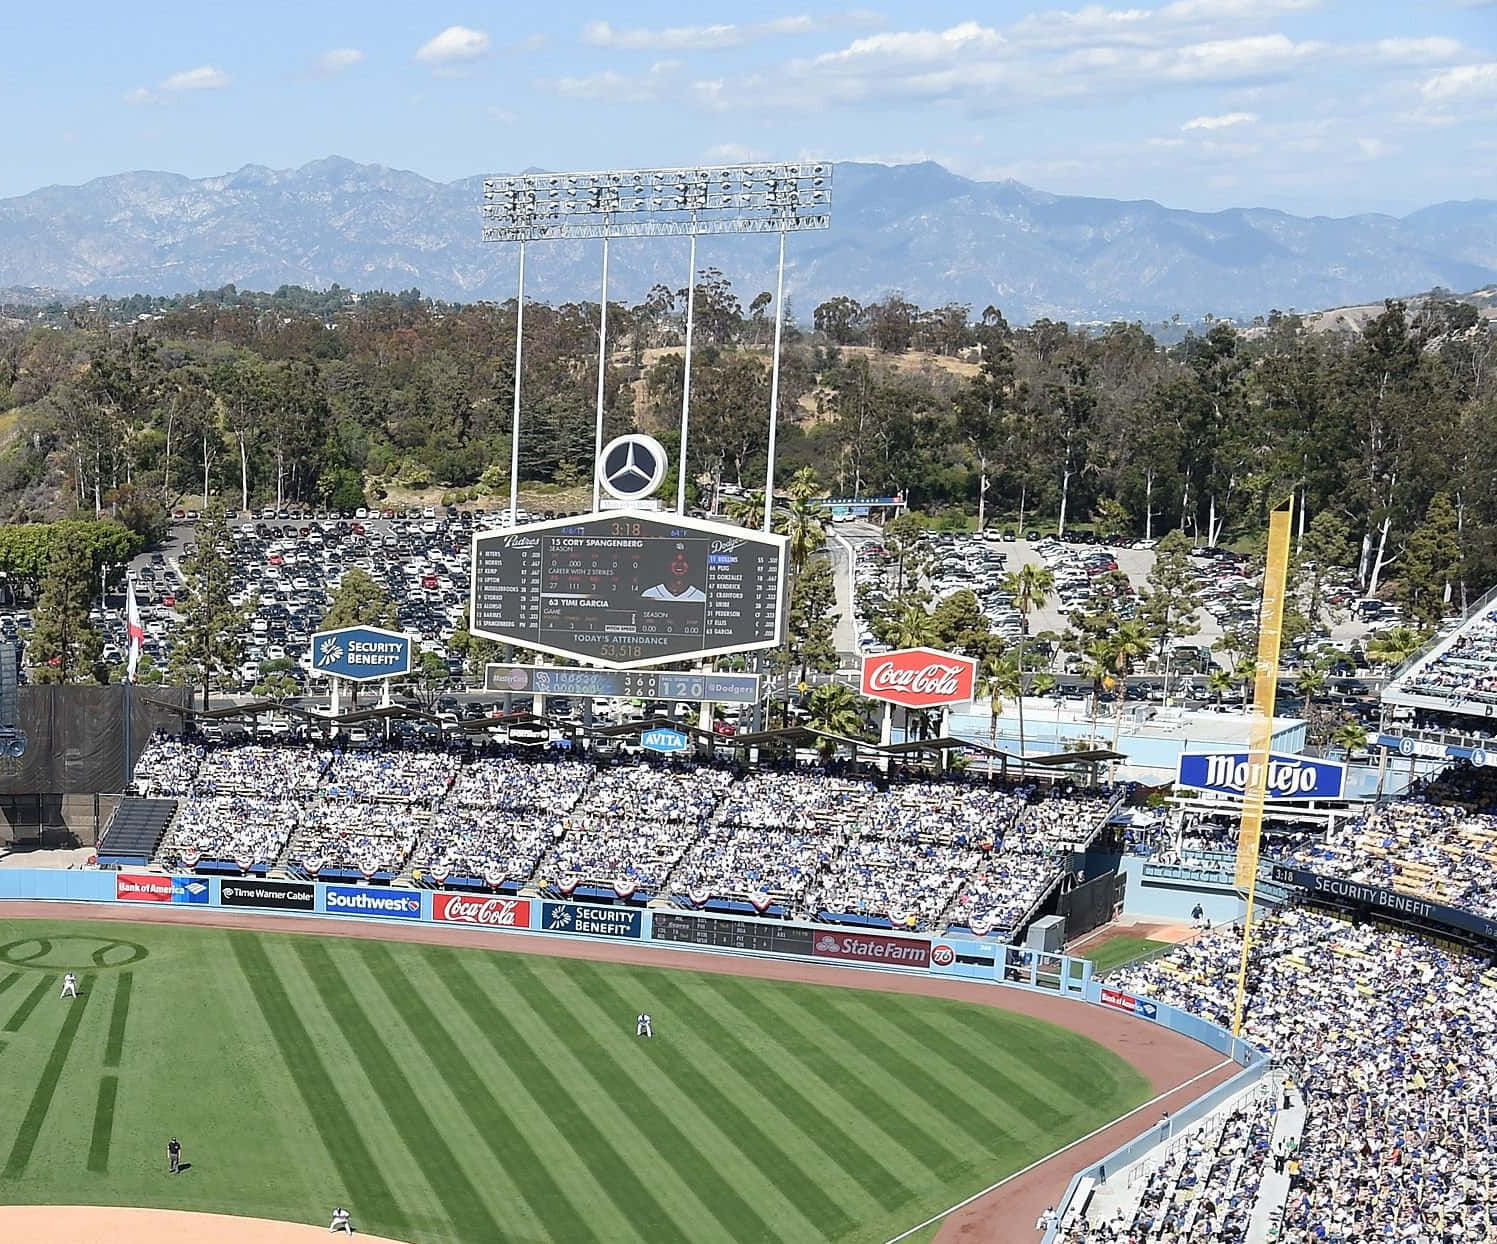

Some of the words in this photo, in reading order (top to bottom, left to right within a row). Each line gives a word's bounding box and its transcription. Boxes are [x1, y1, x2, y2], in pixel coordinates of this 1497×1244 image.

[612, 523, 640, 536] 3:18
[586, 540, 643, 548] SPANGENBERG
[574, 634, 609, 643] TODAY'S
[612, 635, 668, 645] ATTENDANCE
[348, 641, 403, 653] SECURITY
[601, 645, 642, 657] 53,518
[348, 653, 394, 665] BENEFIT
[870, 662, 965, 695] Coca-Cola
[677, 683, 686, 696] 2
[691, 683, 701, 697] 0
[1485, 705, 1493, 716] D
[647, 734, 682, 747] AVITA
[1421, 746, 1442, 755] 1955
[1275, 866, 1294, 882] 3:18
[119, 882, 140, 892] Bank
[141, 883, 150, 893] of
[150, 884, 184, 895] America
[234, 887, 254, 897] Time
[255, 890, 286, 899] Warner
[287, 891, 311, 901] Cable
[327, 891, 408, 912] Southwest
[1315, 877, 1378, 906] SECURITY
[1379, 891, 1432, 917] BENEFIT
[576, 907, 635, 923] SECURITY
[576, 919, 626, 935] BENEFIT
[933, 949, 952, 963] 76
